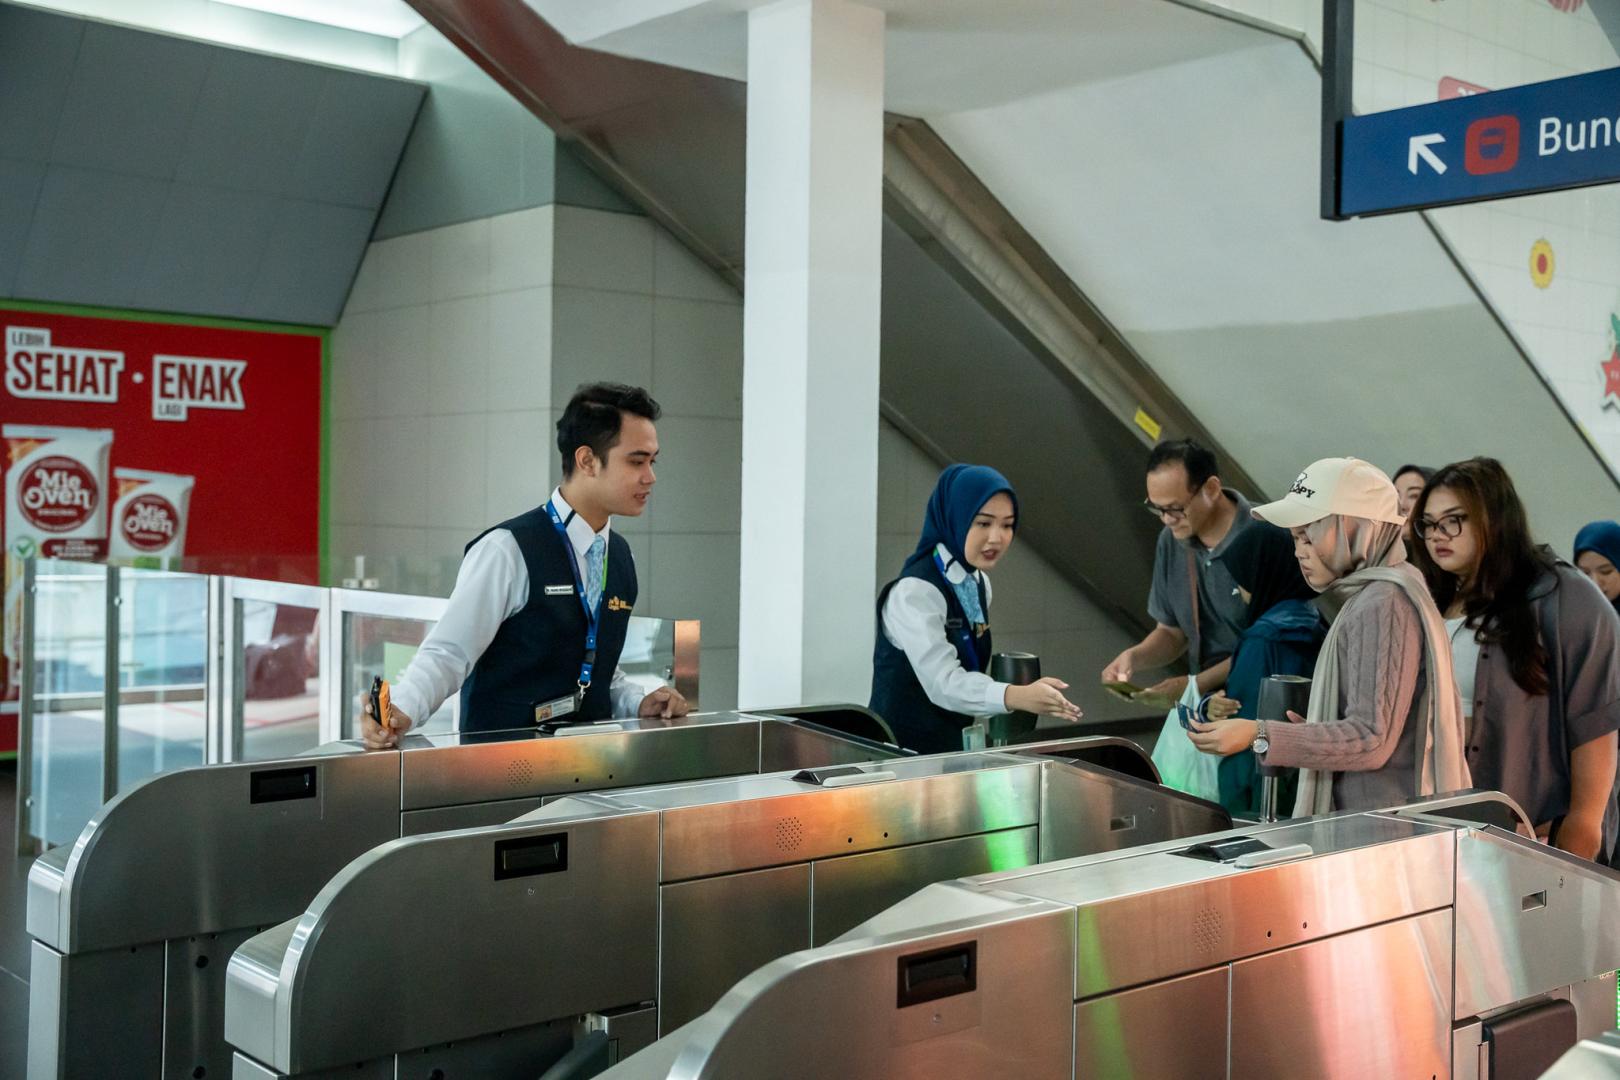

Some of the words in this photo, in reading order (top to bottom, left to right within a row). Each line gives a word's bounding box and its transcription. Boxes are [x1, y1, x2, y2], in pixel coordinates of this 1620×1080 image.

[12, 350, 118, 396] SEHAT
[160, 362, 238, 403] ENAK
[35, 469, 81, 489] Mie
[24, 486, 91, 509] Oven
